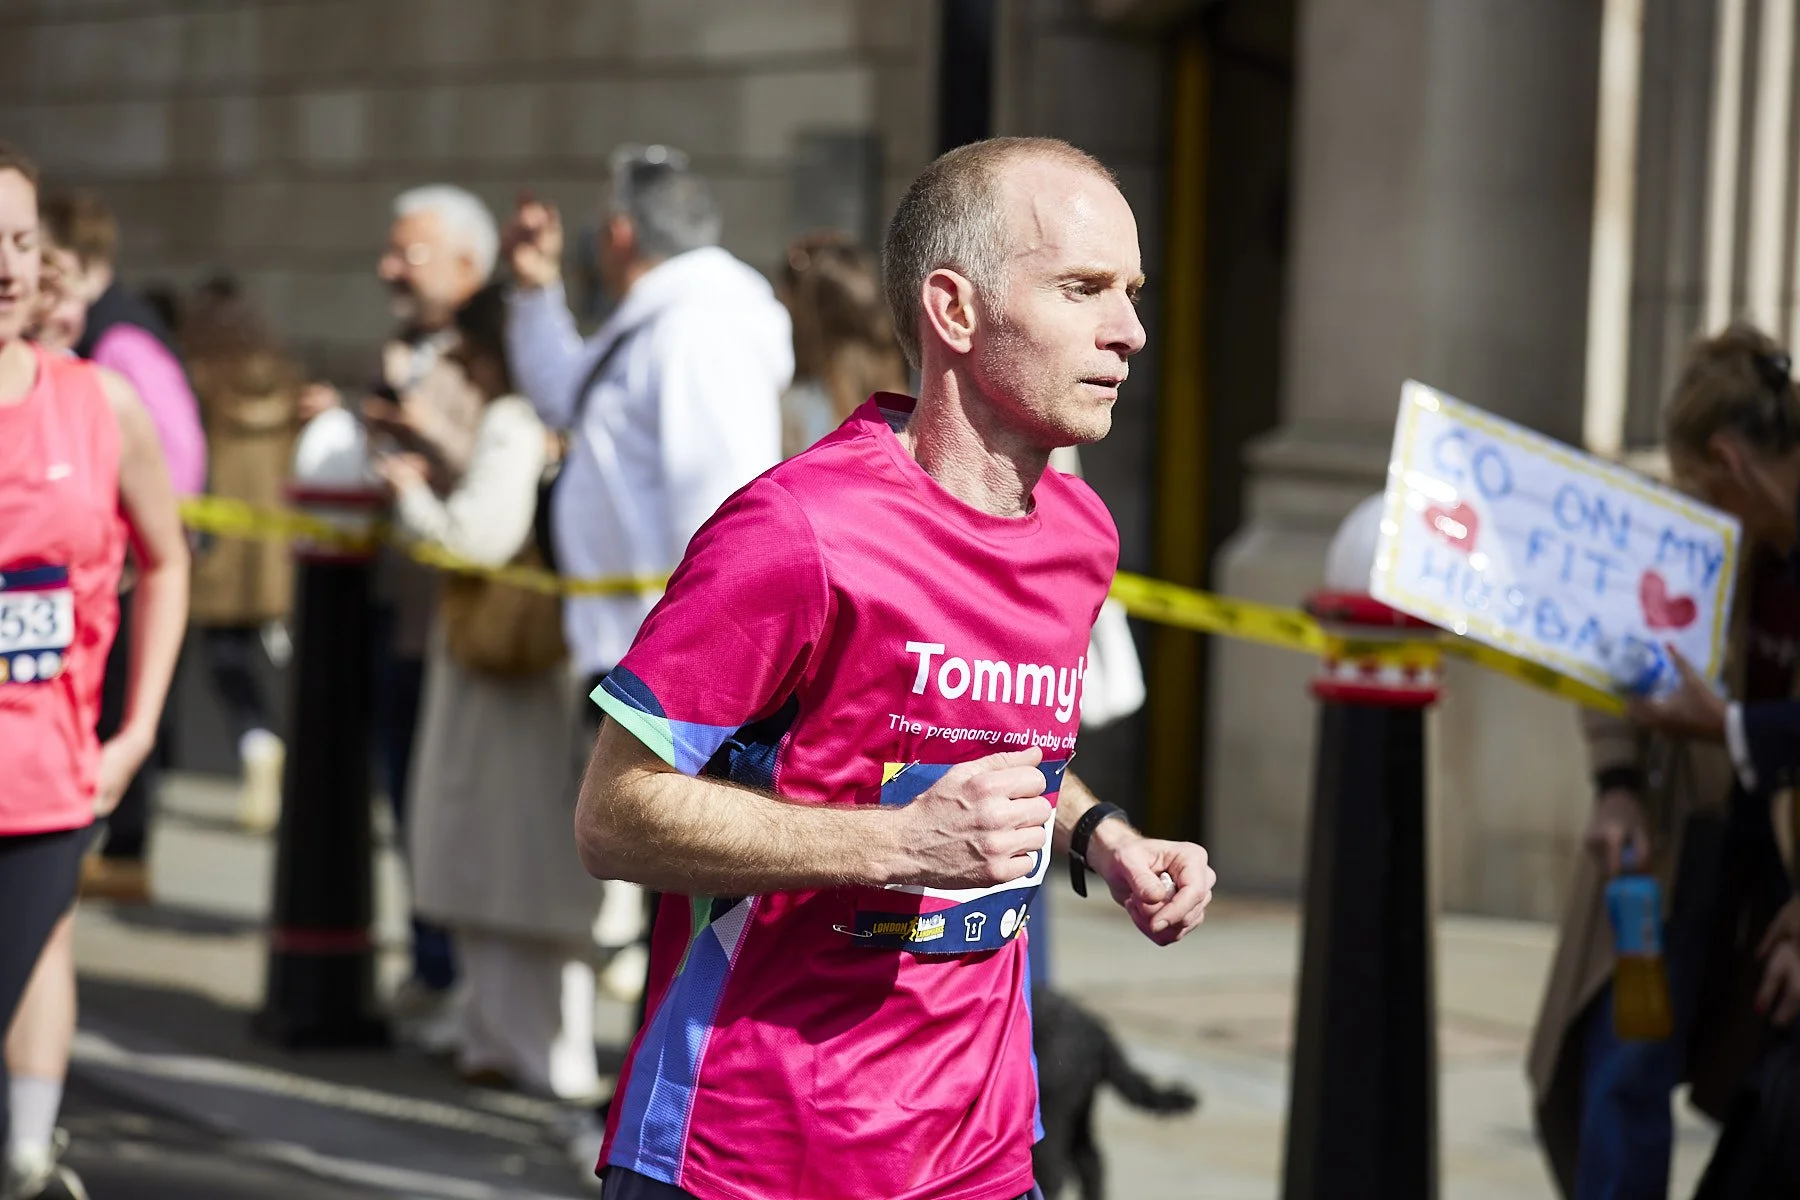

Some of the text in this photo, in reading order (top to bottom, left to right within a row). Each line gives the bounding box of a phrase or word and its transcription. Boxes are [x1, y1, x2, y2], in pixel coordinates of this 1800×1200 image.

[1552, 481, 1632, 551] ON
[1655, 525, 1725, 589] MY
[1525, 526, 1619, 594] FIT
[0, 597, 57, 639] 53
[888, 713, 922, 735] The
[925, 725, 1001, 744] pregnancy
[1004, 728, 1030, 746] and
[1031, 729, 1060, 752] baby
[873, 922, 908, 934] LONDON
